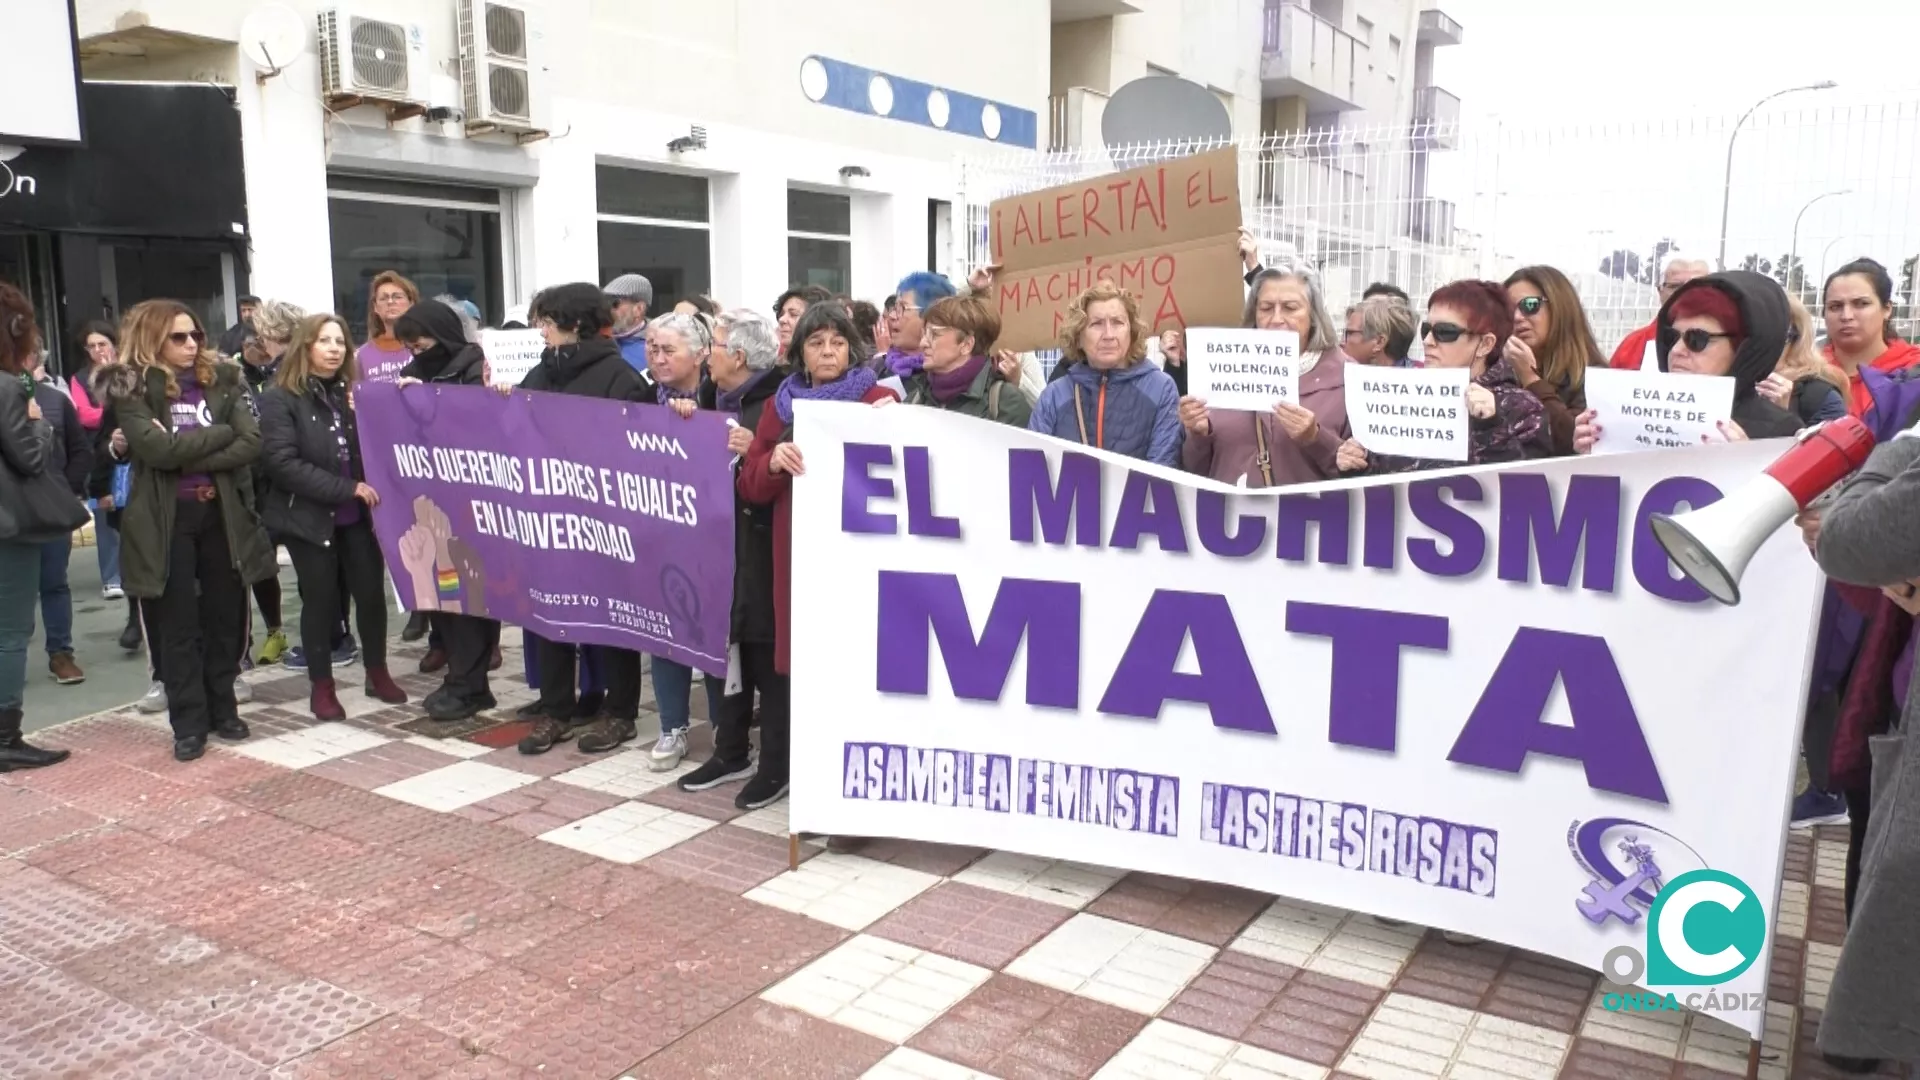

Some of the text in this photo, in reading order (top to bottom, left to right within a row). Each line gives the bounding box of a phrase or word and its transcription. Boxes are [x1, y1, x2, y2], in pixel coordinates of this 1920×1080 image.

[1186, 168, 1228, 209] EL
[1206, 342, 1292, 357] BASTA YA DE
[1209, 362, 1289, 377] VIOLENCIAS
[1211, 382, 1288, 397] MACHISTAS
[1363, 381, 1460, 397] BASTA YA DE
[1633, 388, 1696, 403] EVA AZA
[1365, 402, 1457, 419] VIOLENCIAS
[1621, 405, 1707, 423] MONTES DE
[1368, 424, 1454, 441] MACHISTAS
[393, 444, 698, 527] NOS QUEREMOS LIBRES E IGUALES
[841, 441, 960, 539] EL
[471, 499, 636, 563] EN LA DIVERSIDAD
[529, 588, 671, 626] COLECTIVO FEMINISTA
[876, 569, 1669, 804] MATA
[843, 741, 1011, 813] ASAMBLEA
[1017, 758, 1180, 837] FEMINISTA
[1200, 782, 1270, 853] LAS
[1272, 791, 1367, 872] TRES
[1369, 808, 1498, 899] ROSAS
